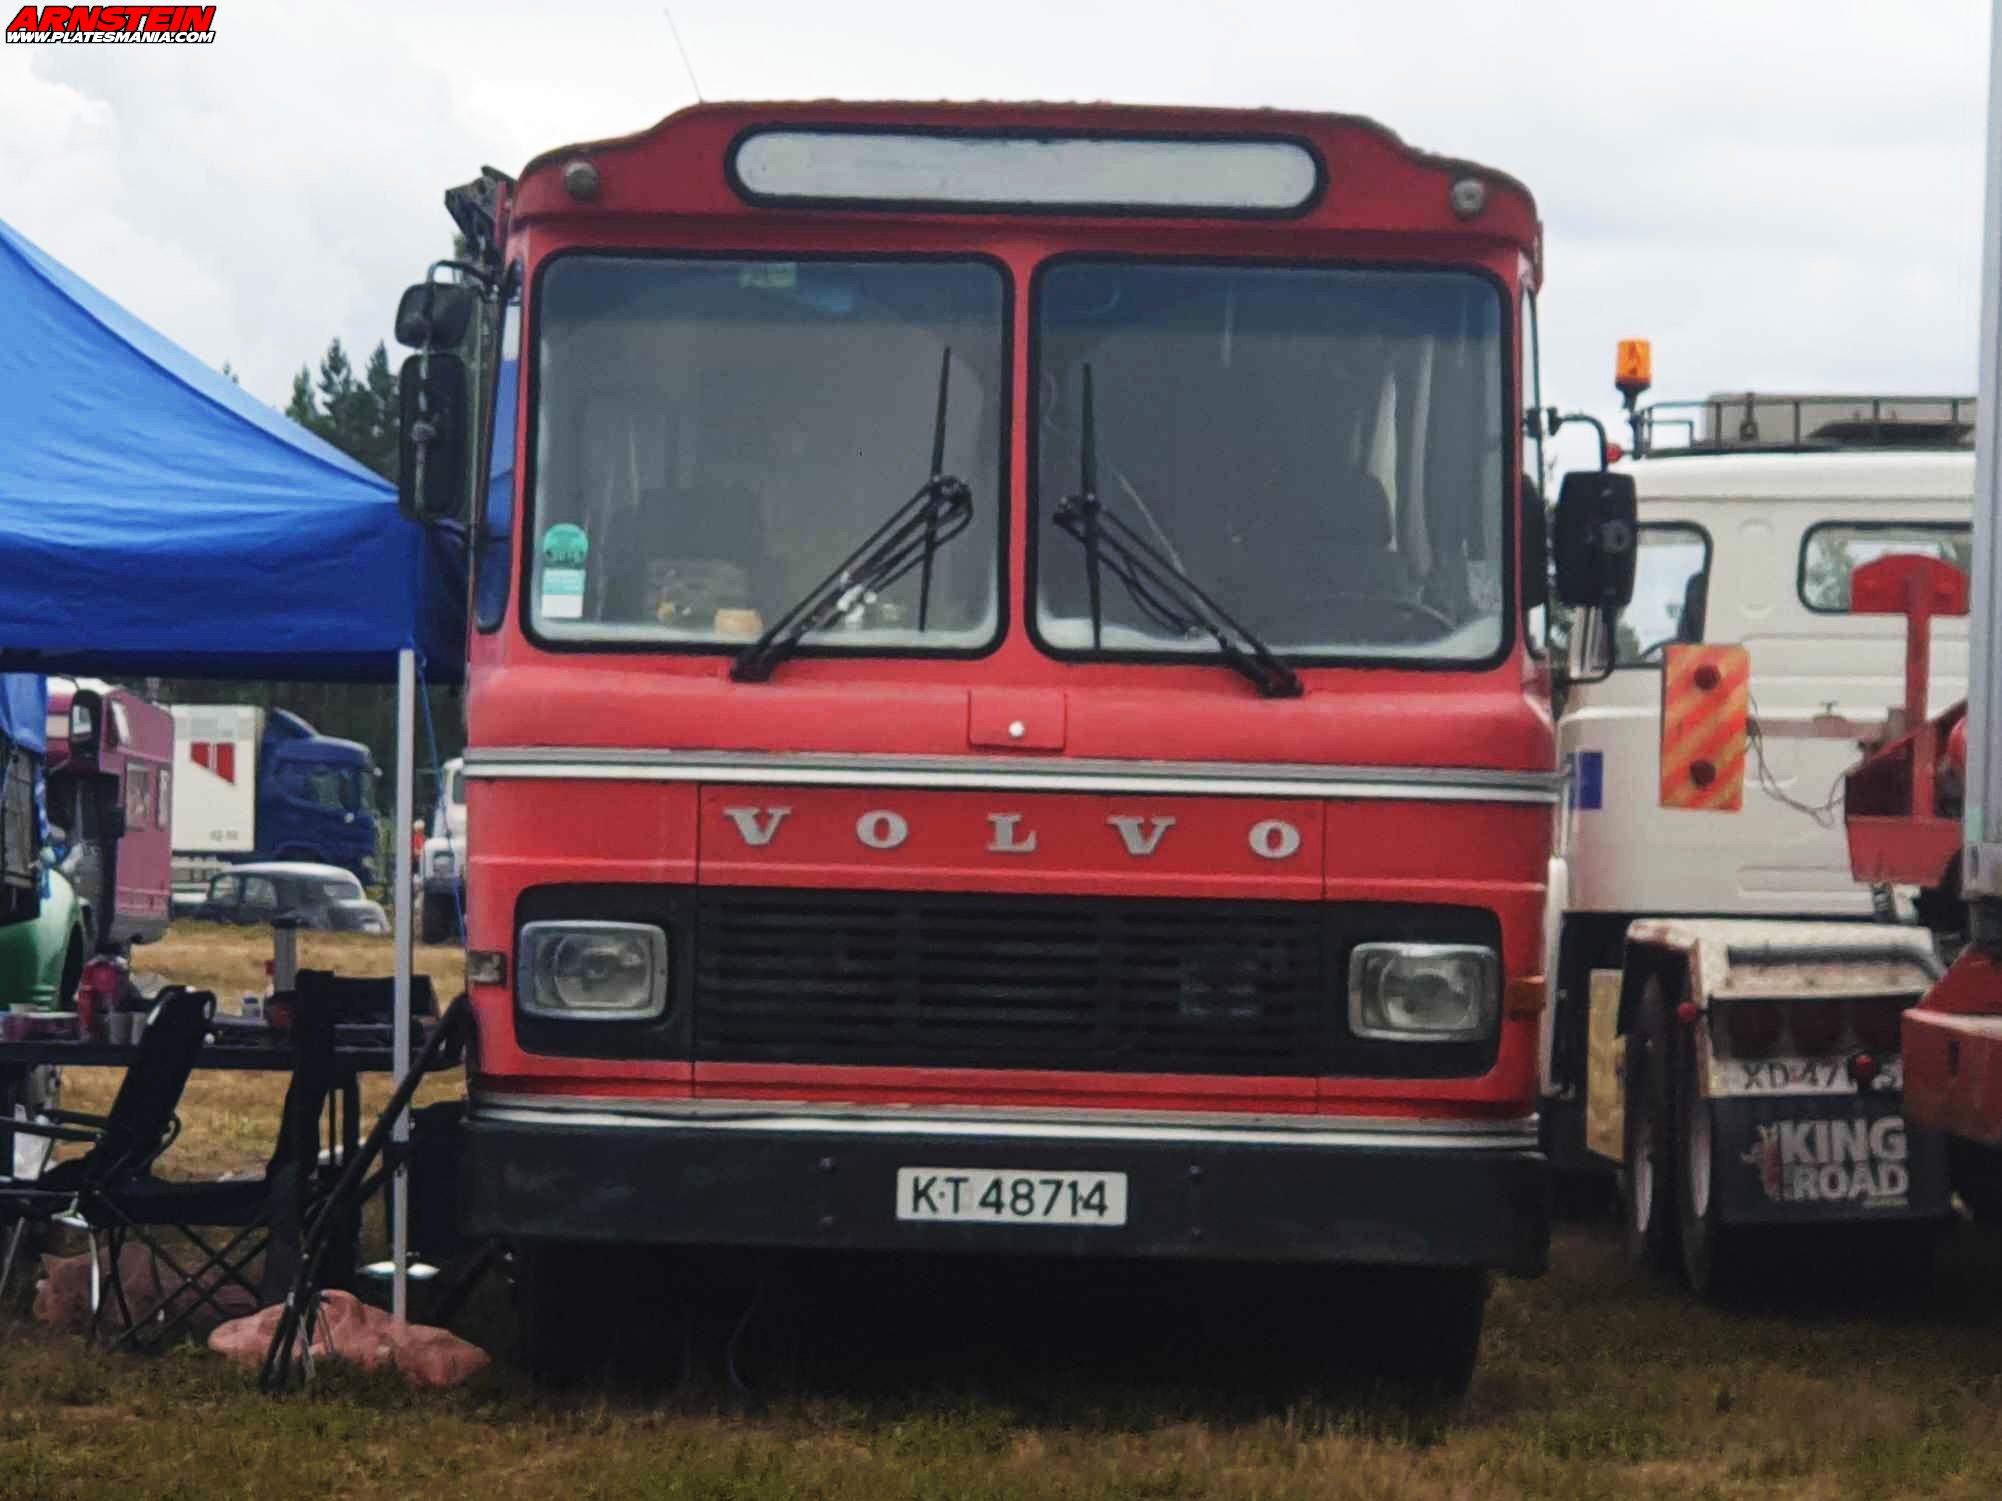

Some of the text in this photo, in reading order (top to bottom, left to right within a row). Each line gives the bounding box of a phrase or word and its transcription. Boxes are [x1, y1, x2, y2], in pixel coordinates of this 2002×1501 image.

[724, 806, 1301, 859] VOLVO
[1779, 1117, 1907, 1163] KING
[912, 1176, 1109, 1217] KT 48714
[1781, 1163, 1909, 1200] ROAD
